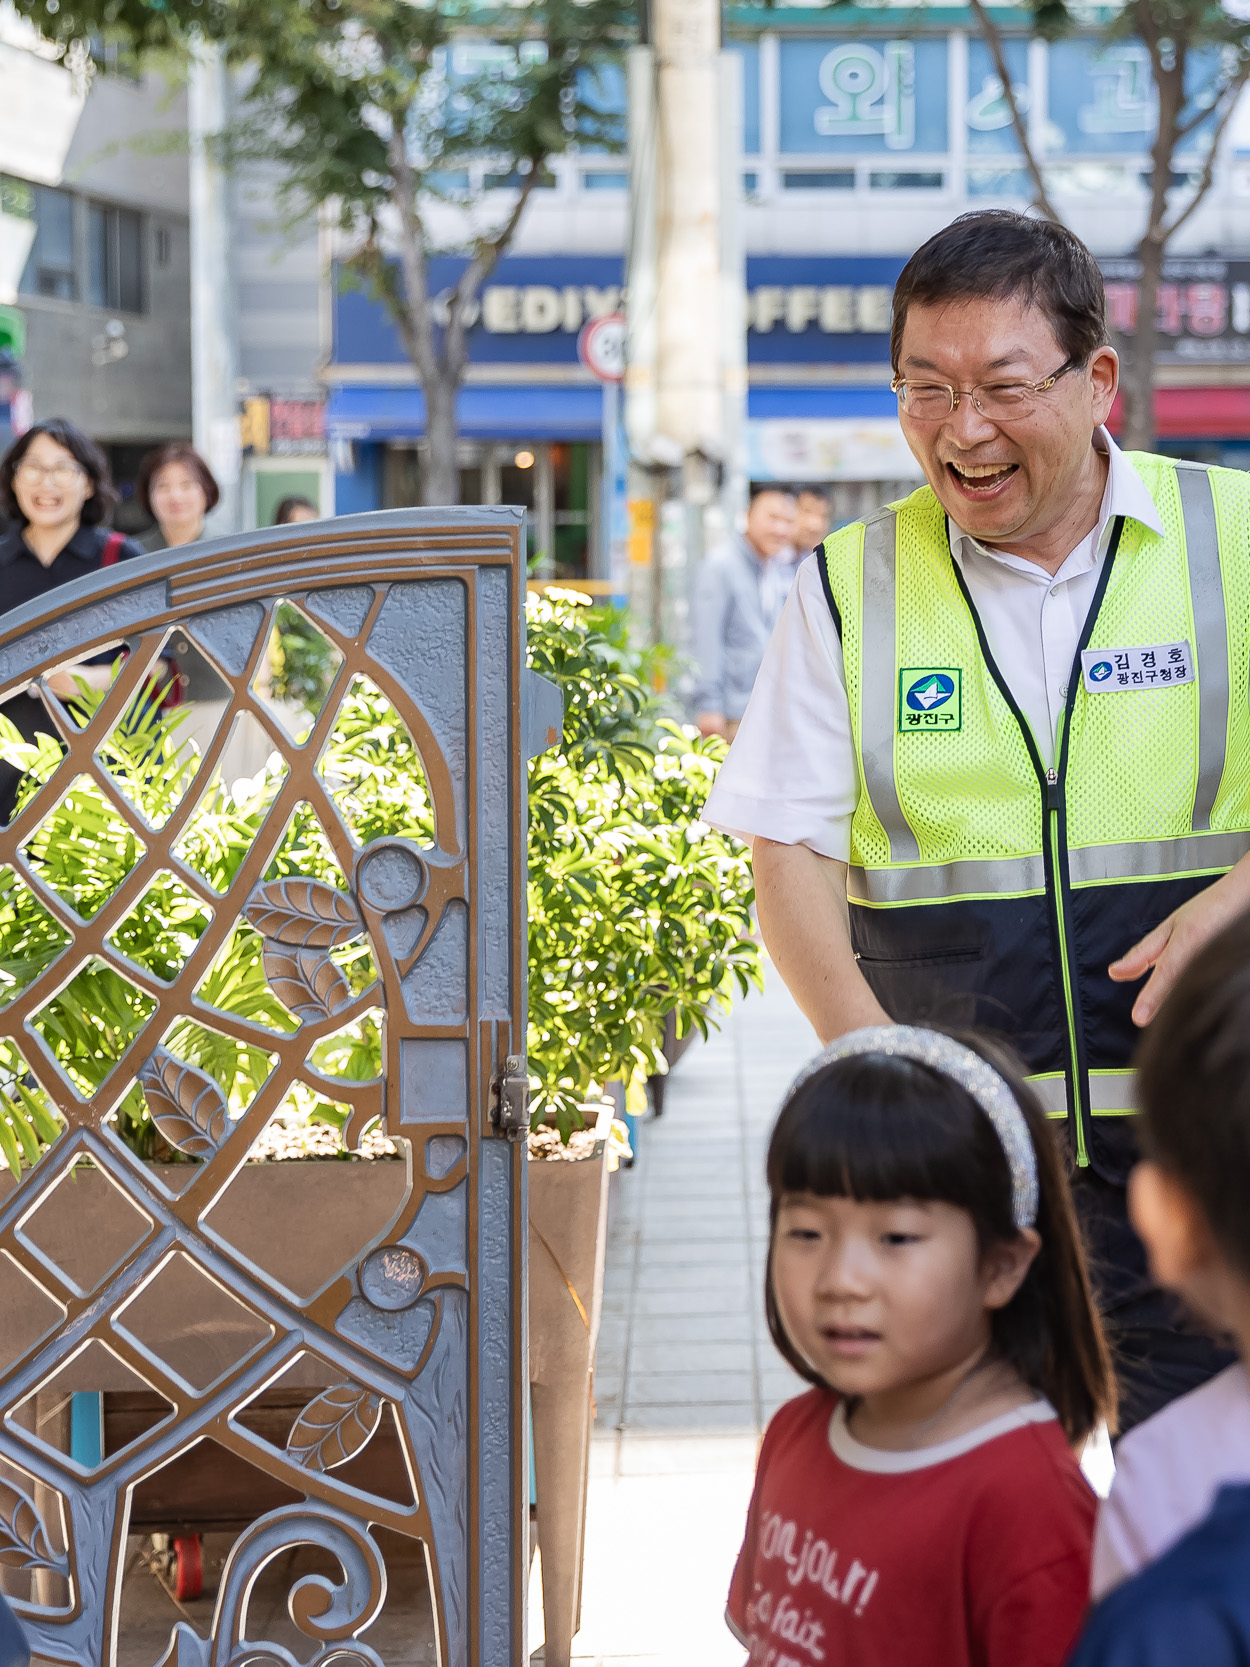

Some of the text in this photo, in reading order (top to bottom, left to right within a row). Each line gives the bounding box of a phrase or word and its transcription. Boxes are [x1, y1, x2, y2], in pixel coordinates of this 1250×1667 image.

[1117, 665, 1187, 685] 광진구청장
[904, 713, 955, 725] 광진구
[761, 1510, 879, 1616] onjour!
